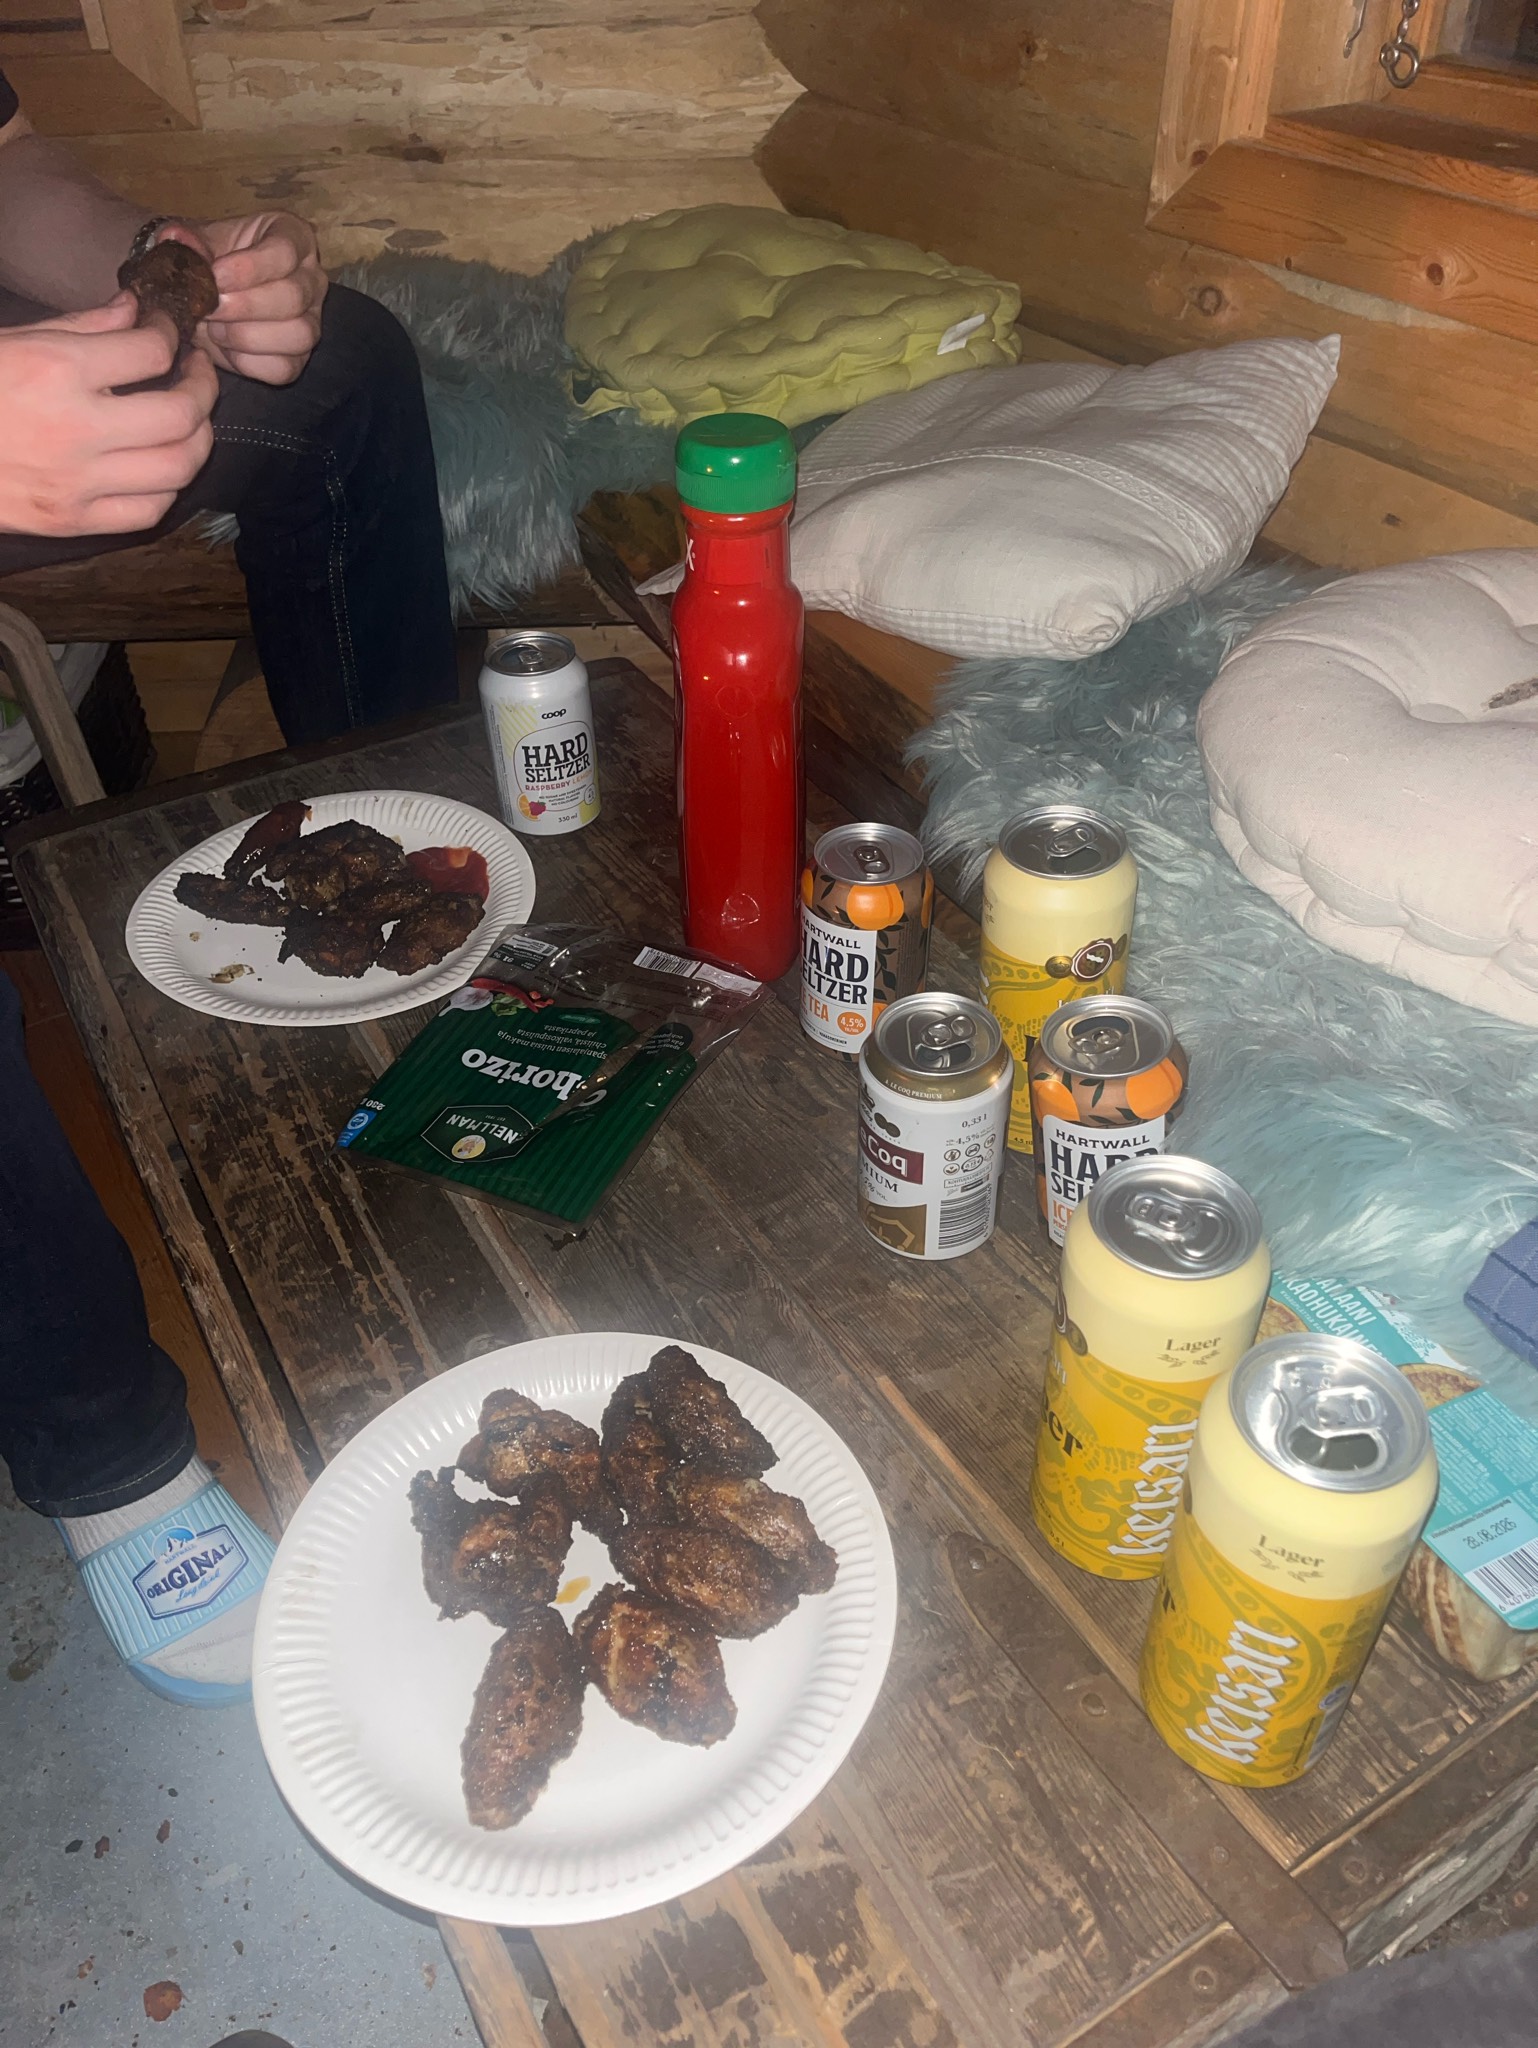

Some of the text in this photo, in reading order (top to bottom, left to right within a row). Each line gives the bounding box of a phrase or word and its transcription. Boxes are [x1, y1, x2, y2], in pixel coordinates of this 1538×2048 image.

[542, 709, 566, 719] coop
[522, 732, 588, 767] HARD
[525, 753, 590, 782] SELTZER
[526, 781, 570, 791] RASPBERRY
[802, 960, 867, 1004] ELTZER
[808, 994, 829, 1022] TEA
[840, 1017, 864, 1028] 4.5%
[497, 1030, 530, 1046] makuja
[517, 1028, 572, 1044] valkosipulista
[530, 1041, 555, 1052] tulisia
[555, 1047, 607, 1059] spanjalaisen
[912, 1088, 942, 1099] PREMIUM
[955, 1132, 980, 1145] 4,5%
[1056, 1129, 1150, 1149] HARTWALL
[860, 1127, 907, 1177] eCoq
[861, 1157, 898, 1193] MIUM
[1166, 1336, 1221, 1353] Lager
[1463, 1518, 1517, 1549] 28.08.2026
[1258, 1534, 1325, 1568] Lager
[147, 1544, 231, 1598] ORIGINAL
